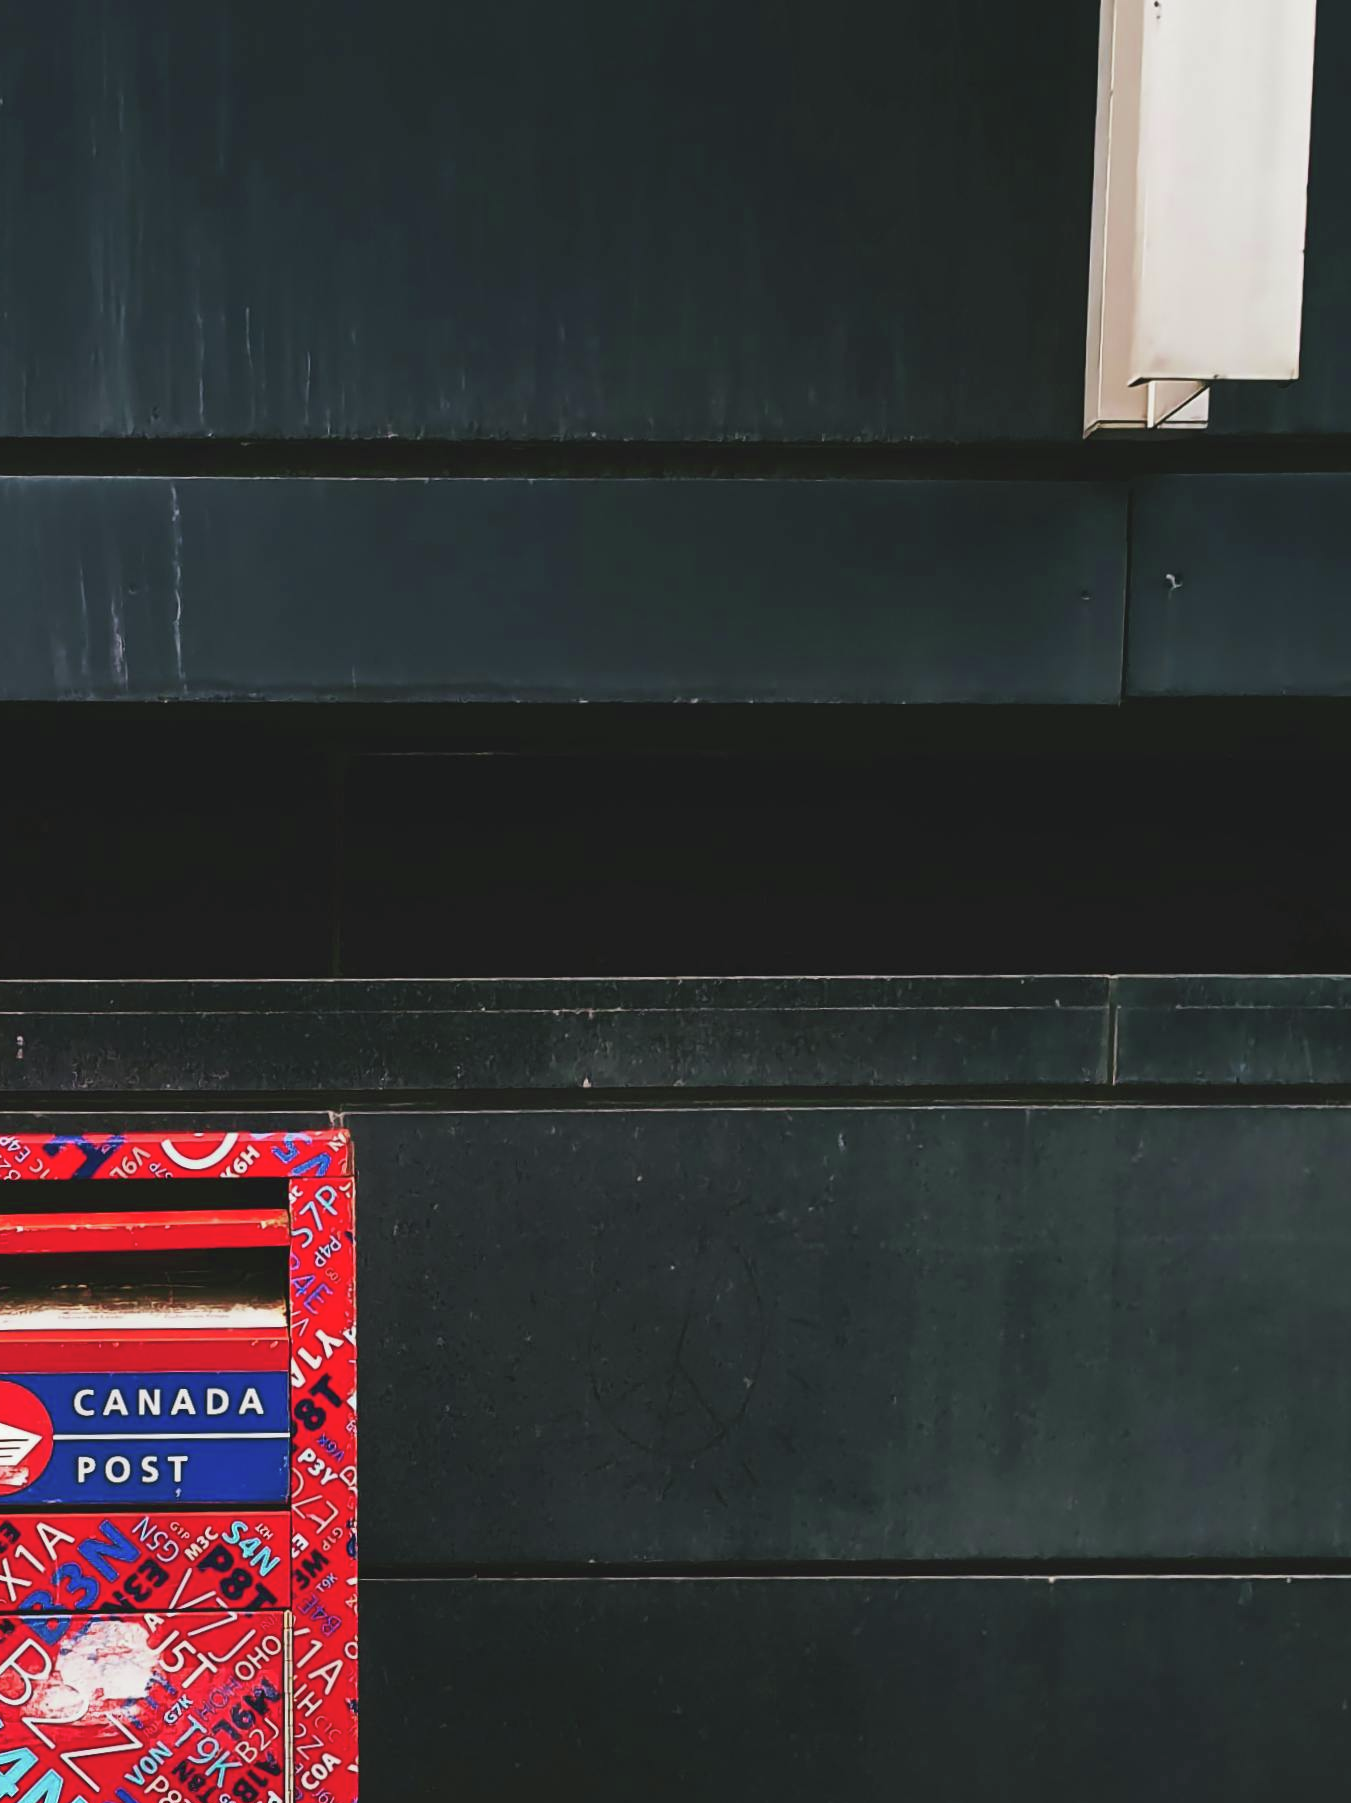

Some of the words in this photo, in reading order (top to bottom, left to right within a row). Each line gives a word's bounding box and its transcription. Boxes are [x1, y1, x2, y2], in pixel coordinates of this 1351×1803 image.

[73, 1388, 264, 1416] CANADA
[77, 1456, 189, 1483] POST
[298, 1447, 339, 1485] P3Y
[132, 1516, 179, 1562] G5N
[184, 1525, 219, 1562] M3C
[222, 1520, 280, 1576] S4N
[17, 1519, 142, 1646] B3N
[197, 1543, 278, 1618] P8T
[167, 1567, 257, 1664] V7J
[164, 1694, 193, 1725] G7K
[175, 1714, 243, 1788] T9K
[233, 1752, 282, 1803] A1B
